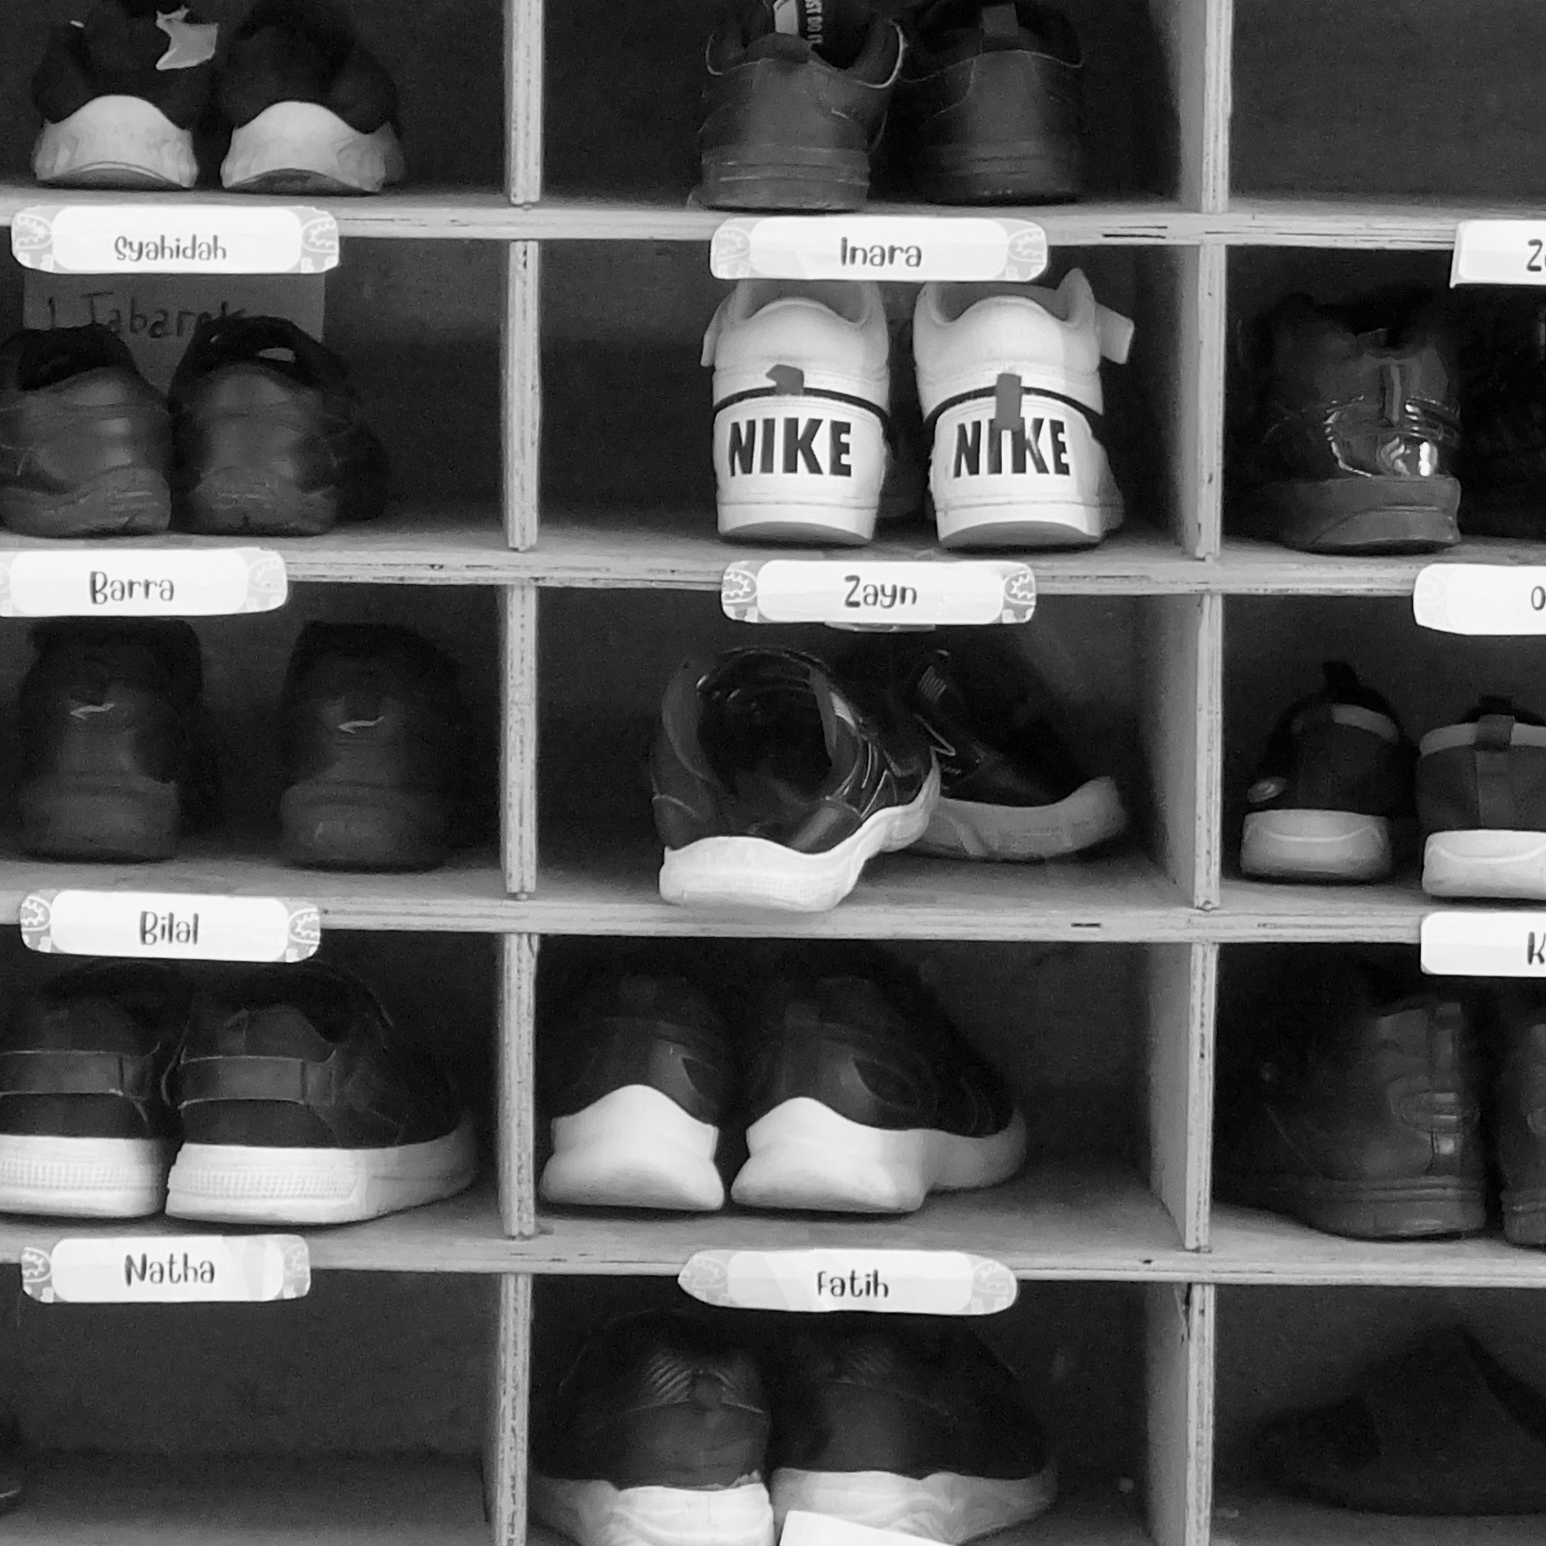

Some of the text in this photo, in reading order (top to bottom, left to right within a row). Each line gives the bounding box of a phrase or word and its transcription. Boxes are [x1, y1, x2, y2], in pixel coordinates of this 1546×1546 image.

[114, 234, 226, 262] Syahidah
[841, 237, 922, 267] Inara
[728, 418, 853, 478] NIKE
[954, 418, 1070, 478] NIKE
[90, 571, 174, 604] Barra
[845, 575, 917, 608] Zayn
[140, 911, 199, 945] Bilal
[125, 1253, 215, 1286] Natha
[818, 1270, 889, 1297] Fatih
